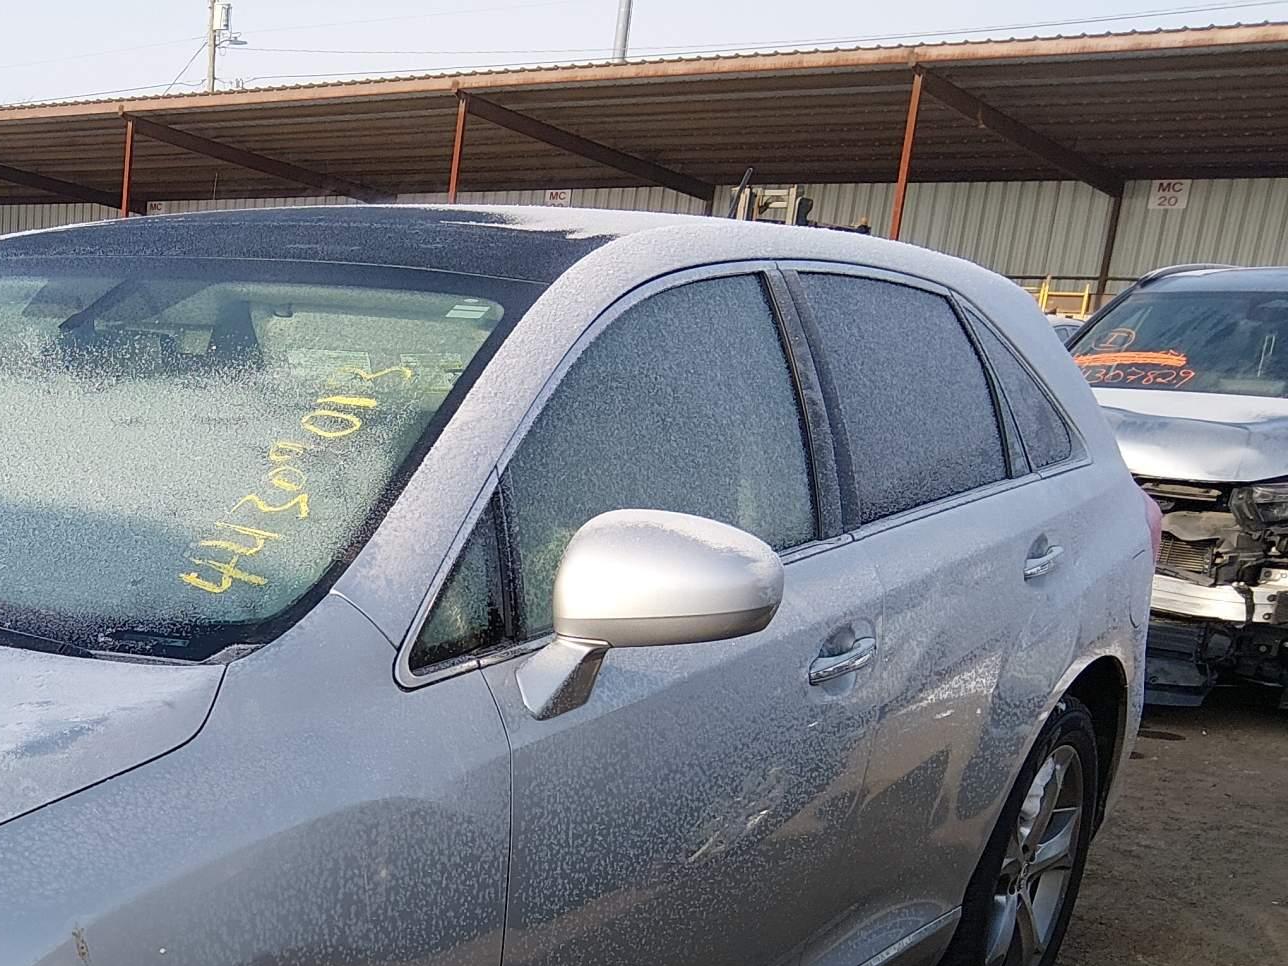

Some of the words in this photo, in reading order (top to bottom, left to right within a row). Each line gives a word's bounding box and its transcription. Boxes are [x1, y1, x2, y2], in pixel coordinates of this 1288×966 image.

[1157, 181, 1183, 193] MC
[549, 191, 567, 201] MC
[1157, 195, 1178, 207] 20
[178, 365, 415, 594] 44309013
